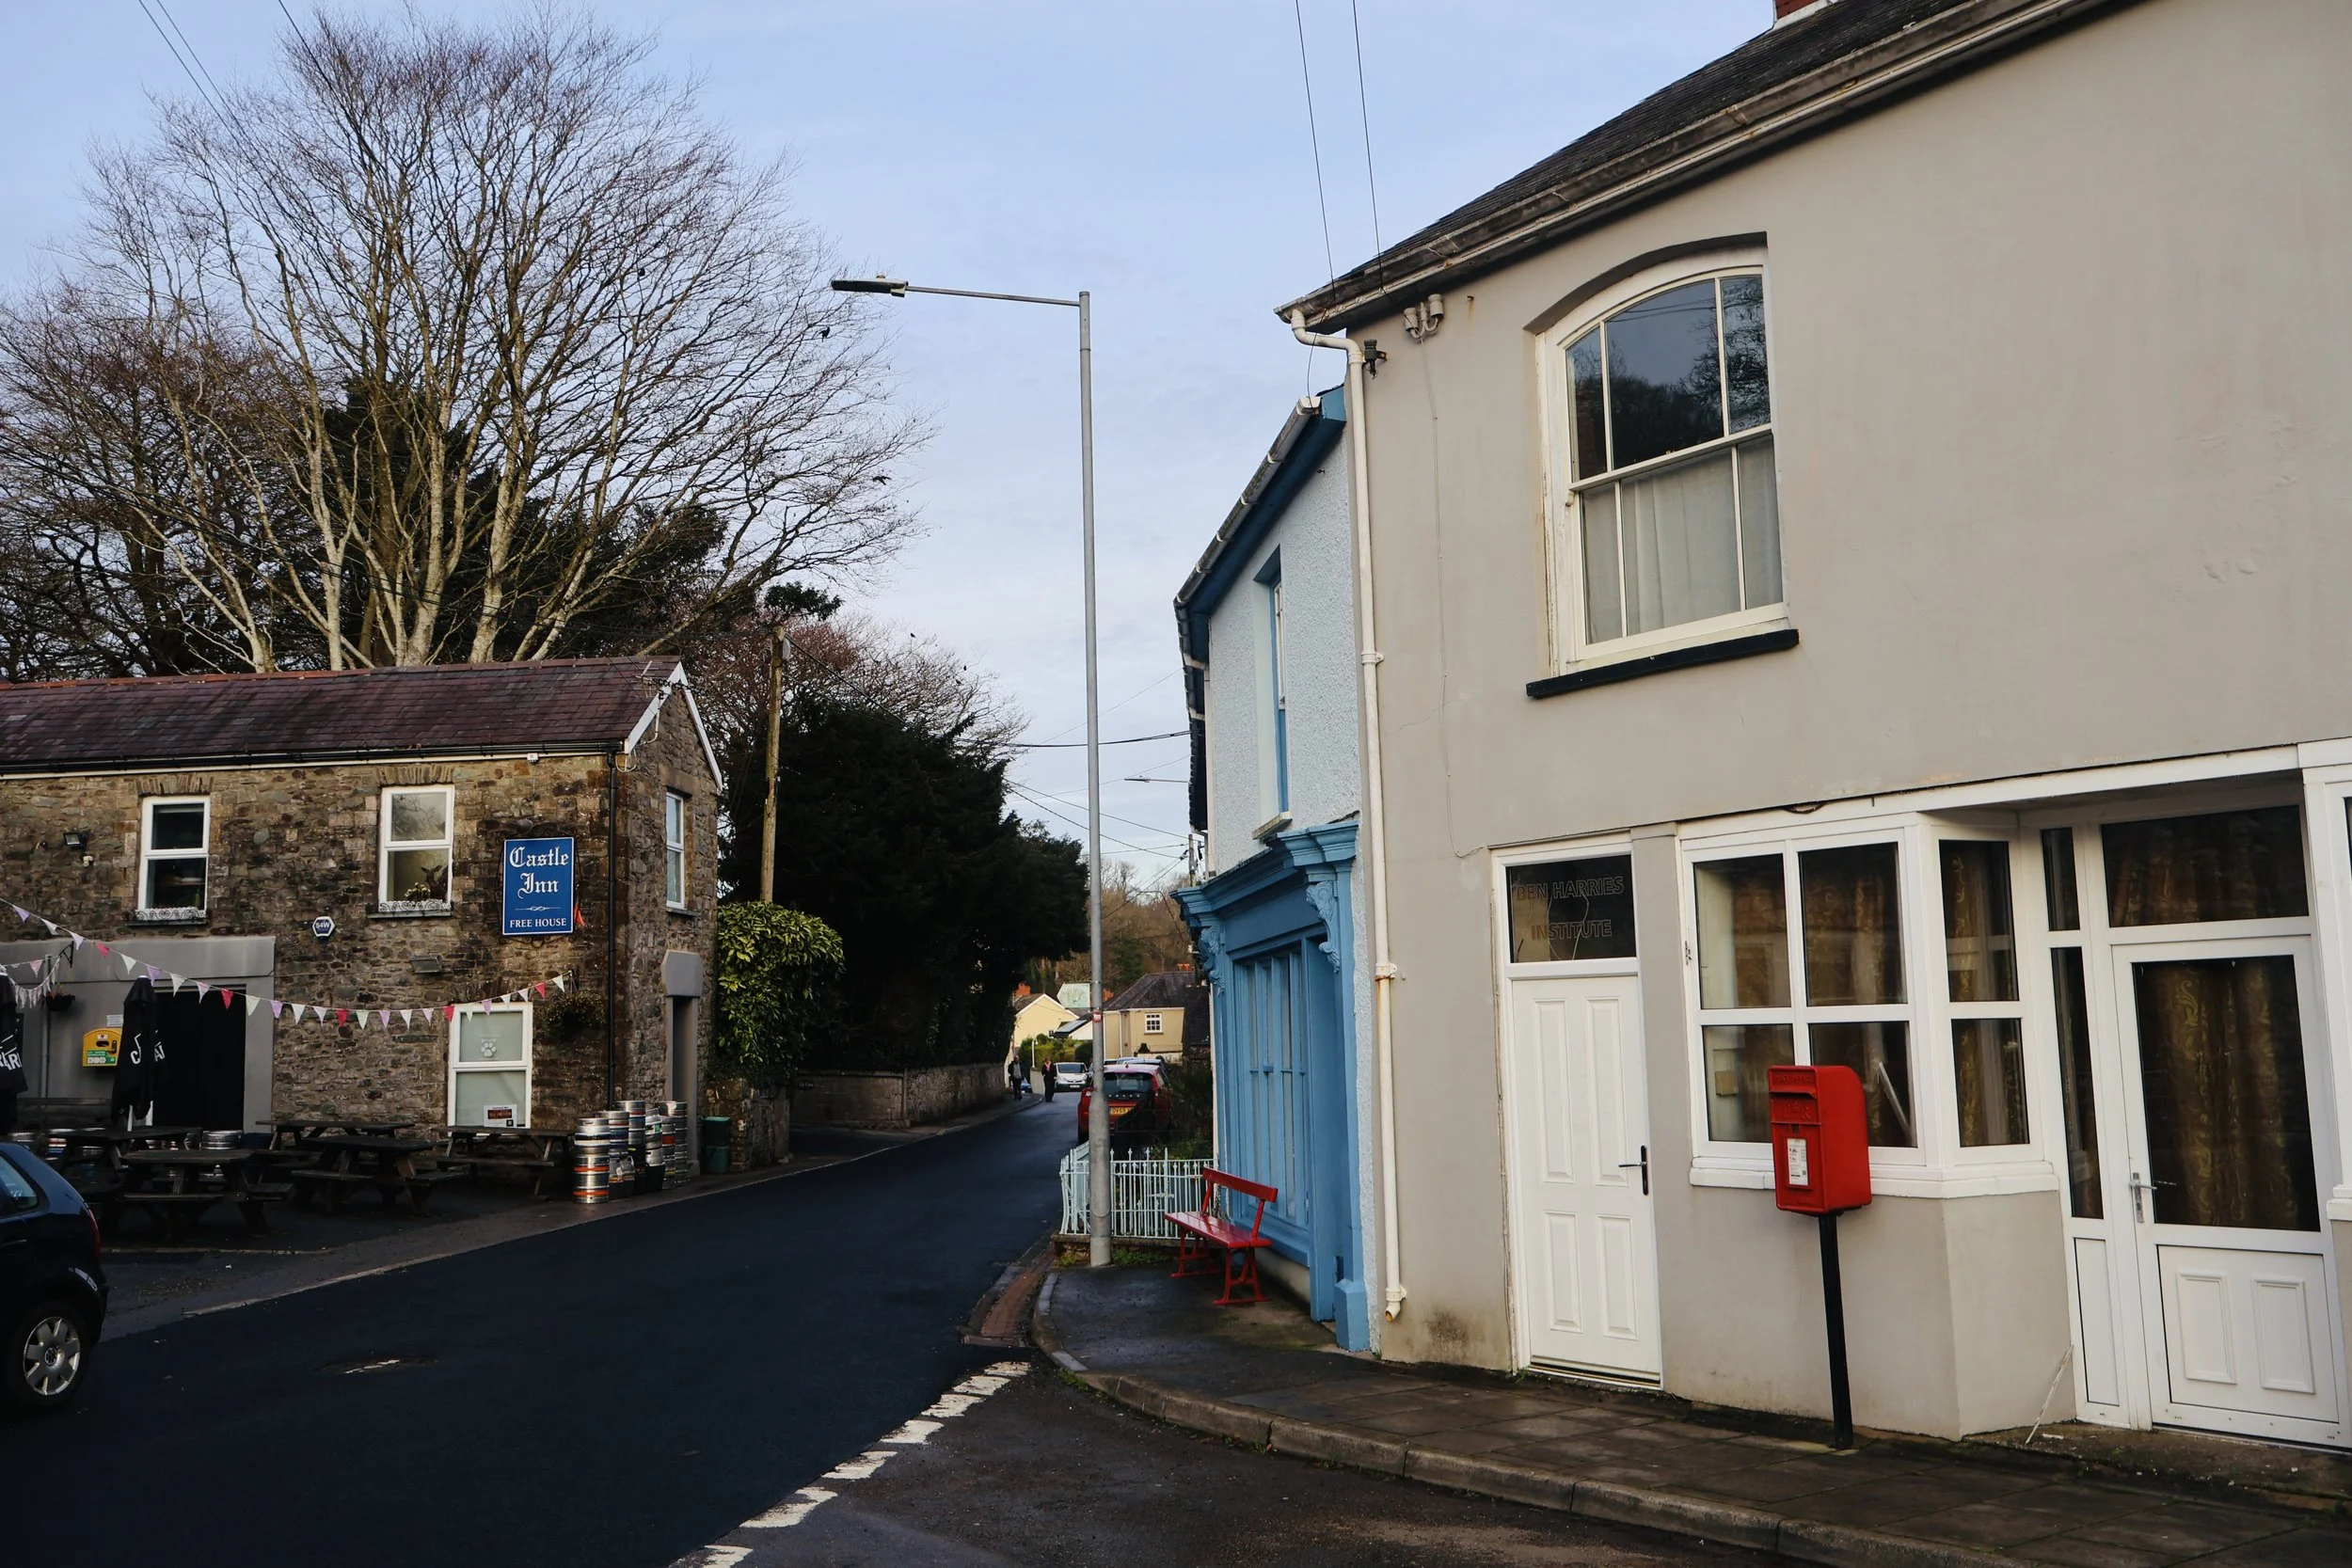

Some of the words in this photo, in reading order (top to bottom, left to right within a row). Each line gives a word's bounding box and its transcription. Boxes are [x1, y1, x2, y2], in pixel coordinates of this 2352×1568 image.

[509, 846, 569, 868] Castle
[516, 872, 560, 899] Inn
[1517, 882, 1548, 901] BEN
[1552, 876, 1625, 899] HARRIES
[509, 919, 532, 928] FREE
[534, 918, 567, 927] HOUSE
[1531, 919, 1613, 941] INSTITUTE
